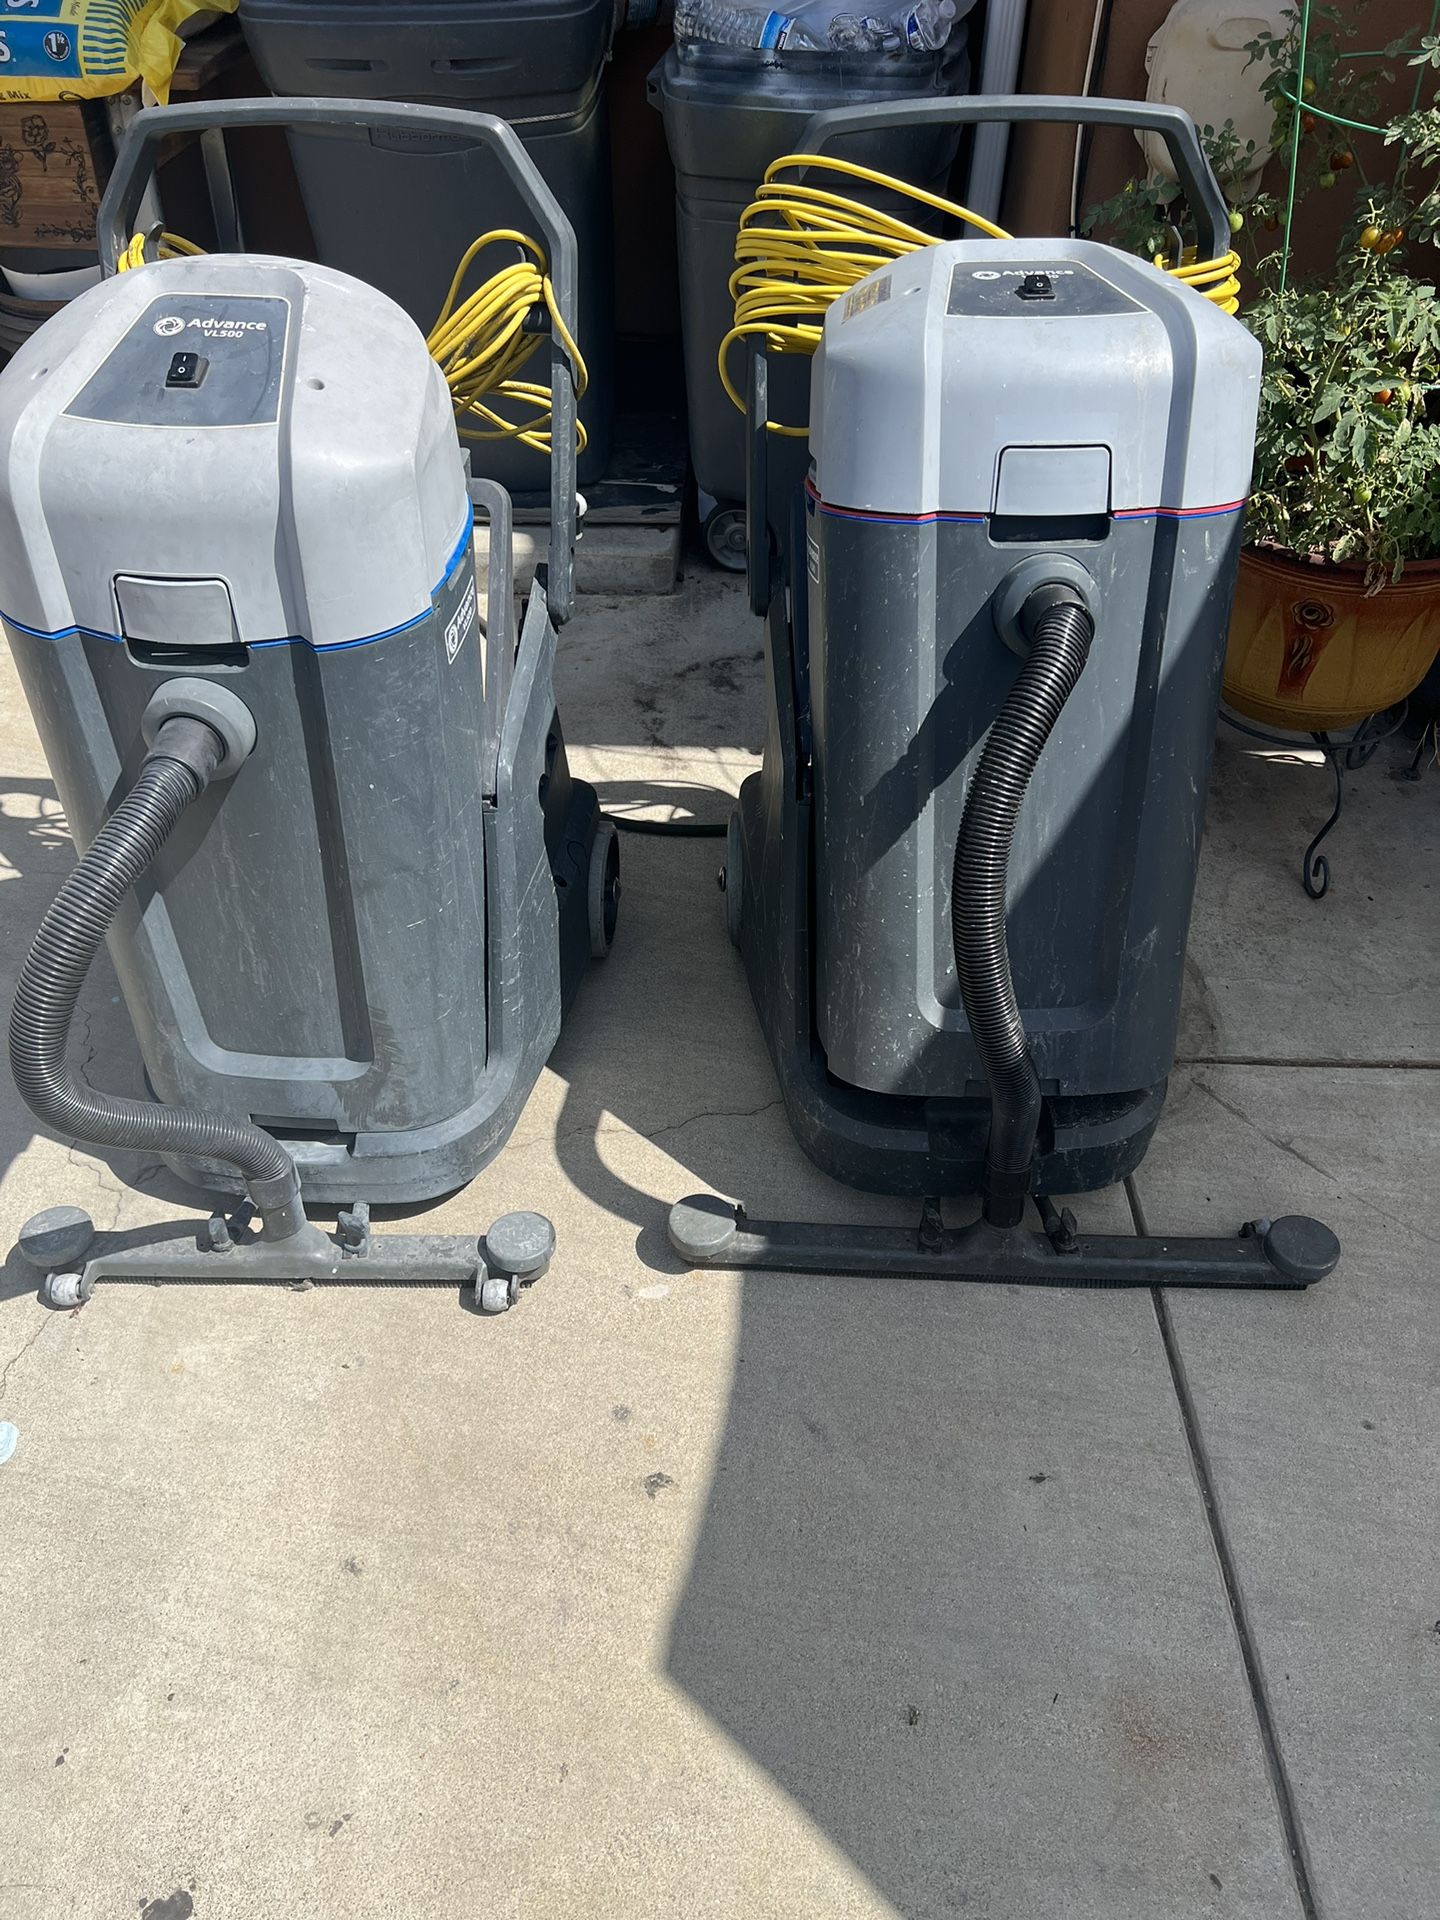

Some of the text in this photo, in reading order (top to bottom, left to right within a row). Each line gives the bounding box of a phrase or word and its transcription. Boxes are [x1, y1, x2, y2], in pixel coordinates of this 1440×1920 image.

[6, 90, 31, 99] Mix
[1002, 270, 1074, 278] Advance
[187, 318, 267, 330] Advance
[203, 329, 244, 338] VL500
